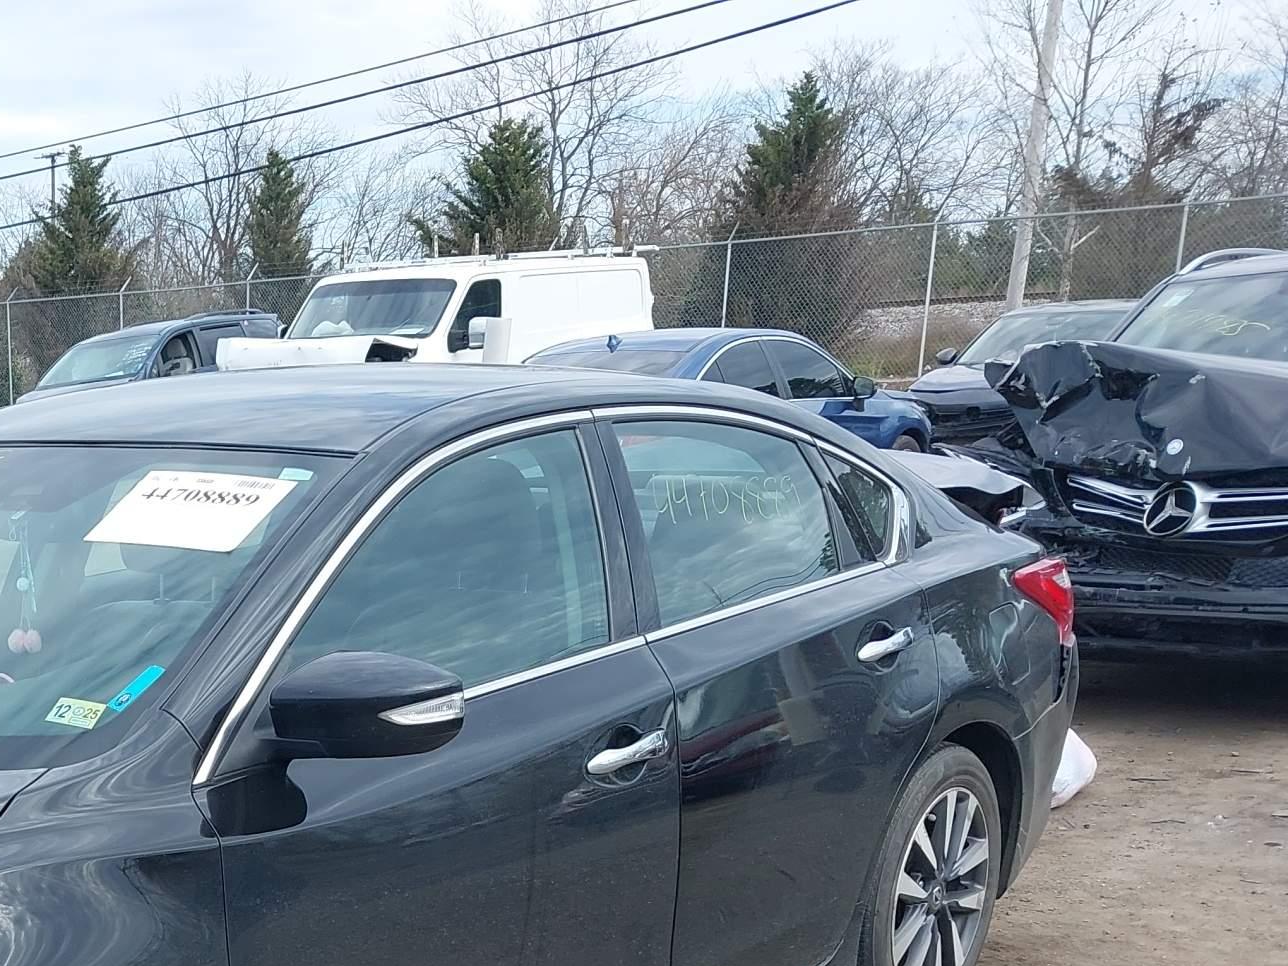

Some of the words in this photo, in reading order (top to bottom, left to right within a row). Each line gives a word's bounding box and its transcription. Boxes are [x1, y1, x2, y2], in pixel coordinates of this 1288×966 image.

[142, 487, 261, 507] 44708889
[53, 703, 72, 719] 12
[83, 707, 102, 720] 25
